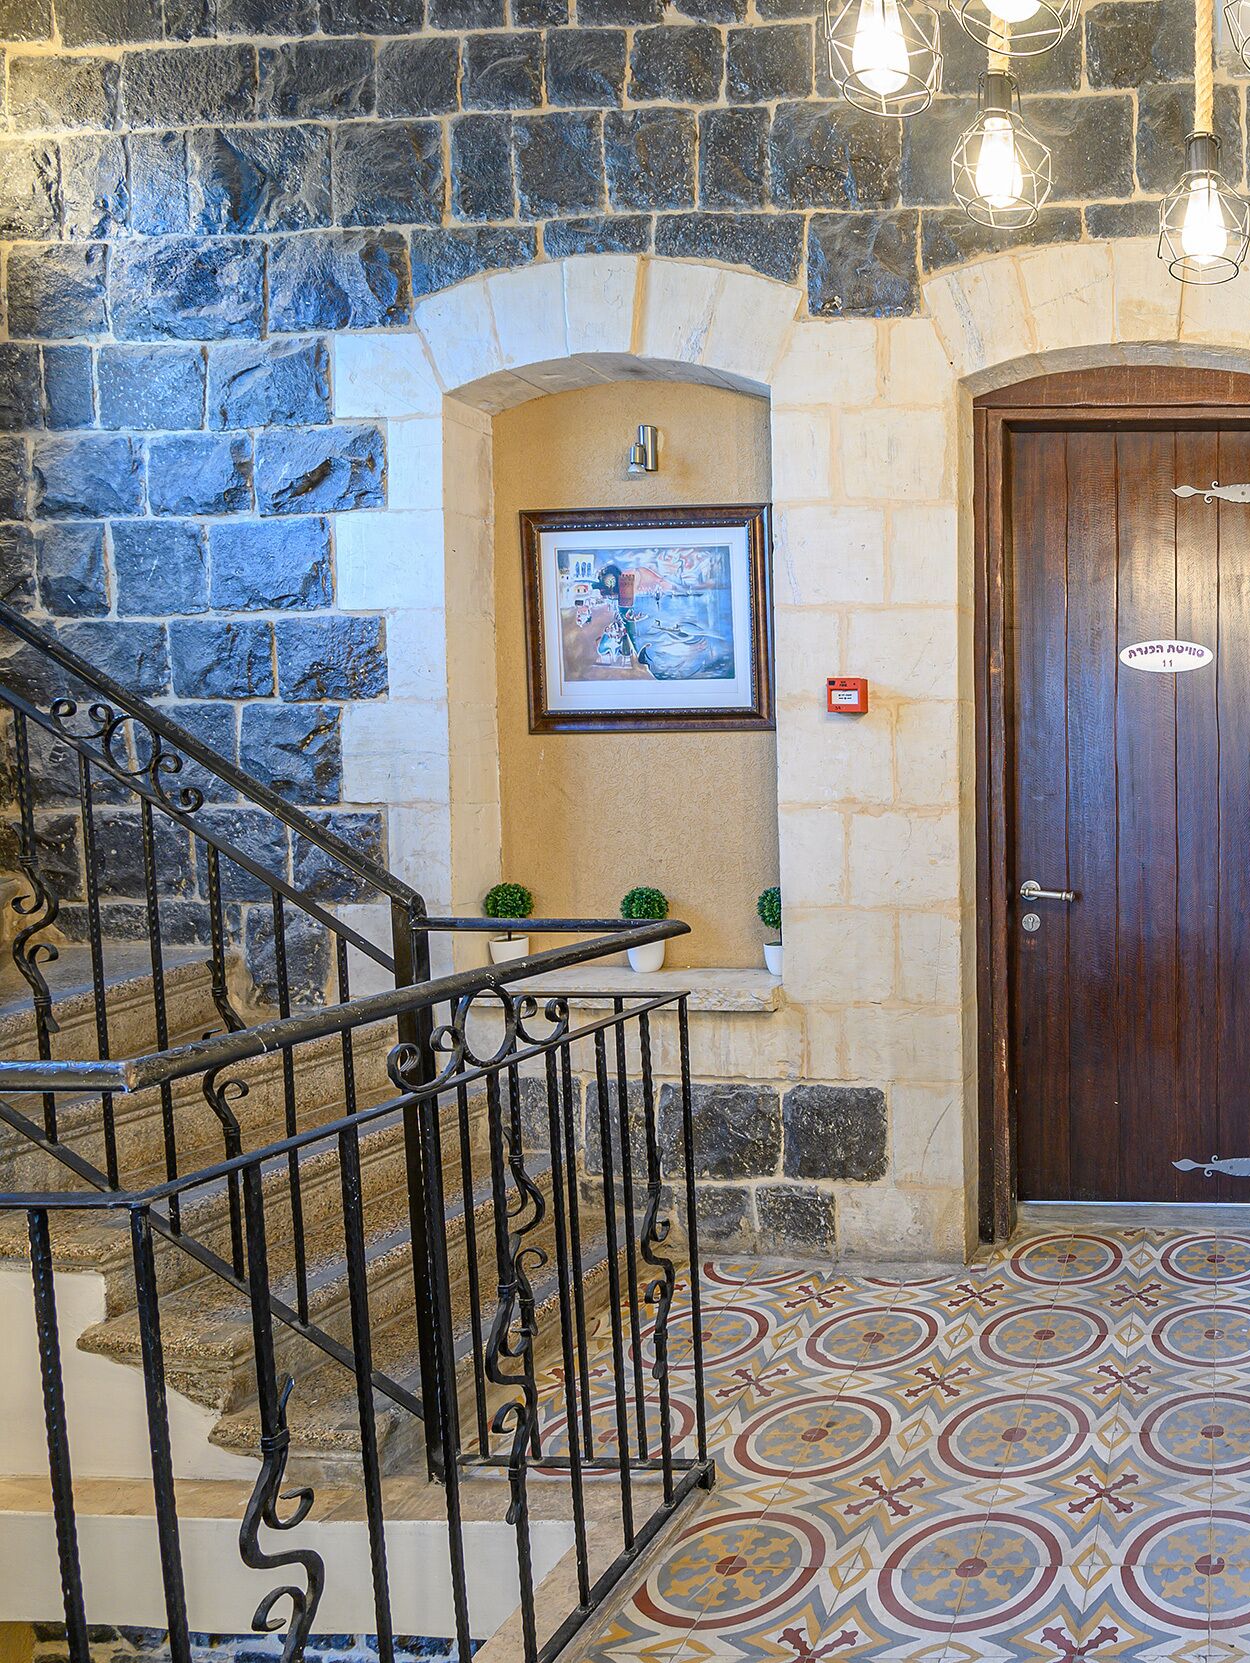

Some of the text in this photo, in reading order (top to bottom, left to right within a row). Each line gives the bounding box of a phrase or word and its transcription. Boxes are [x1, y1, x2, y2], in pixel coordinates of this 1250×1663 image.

[1128, 644, 1205, 659] סוויטת הכנרת
[1162, 659, 1173, 667] 11
